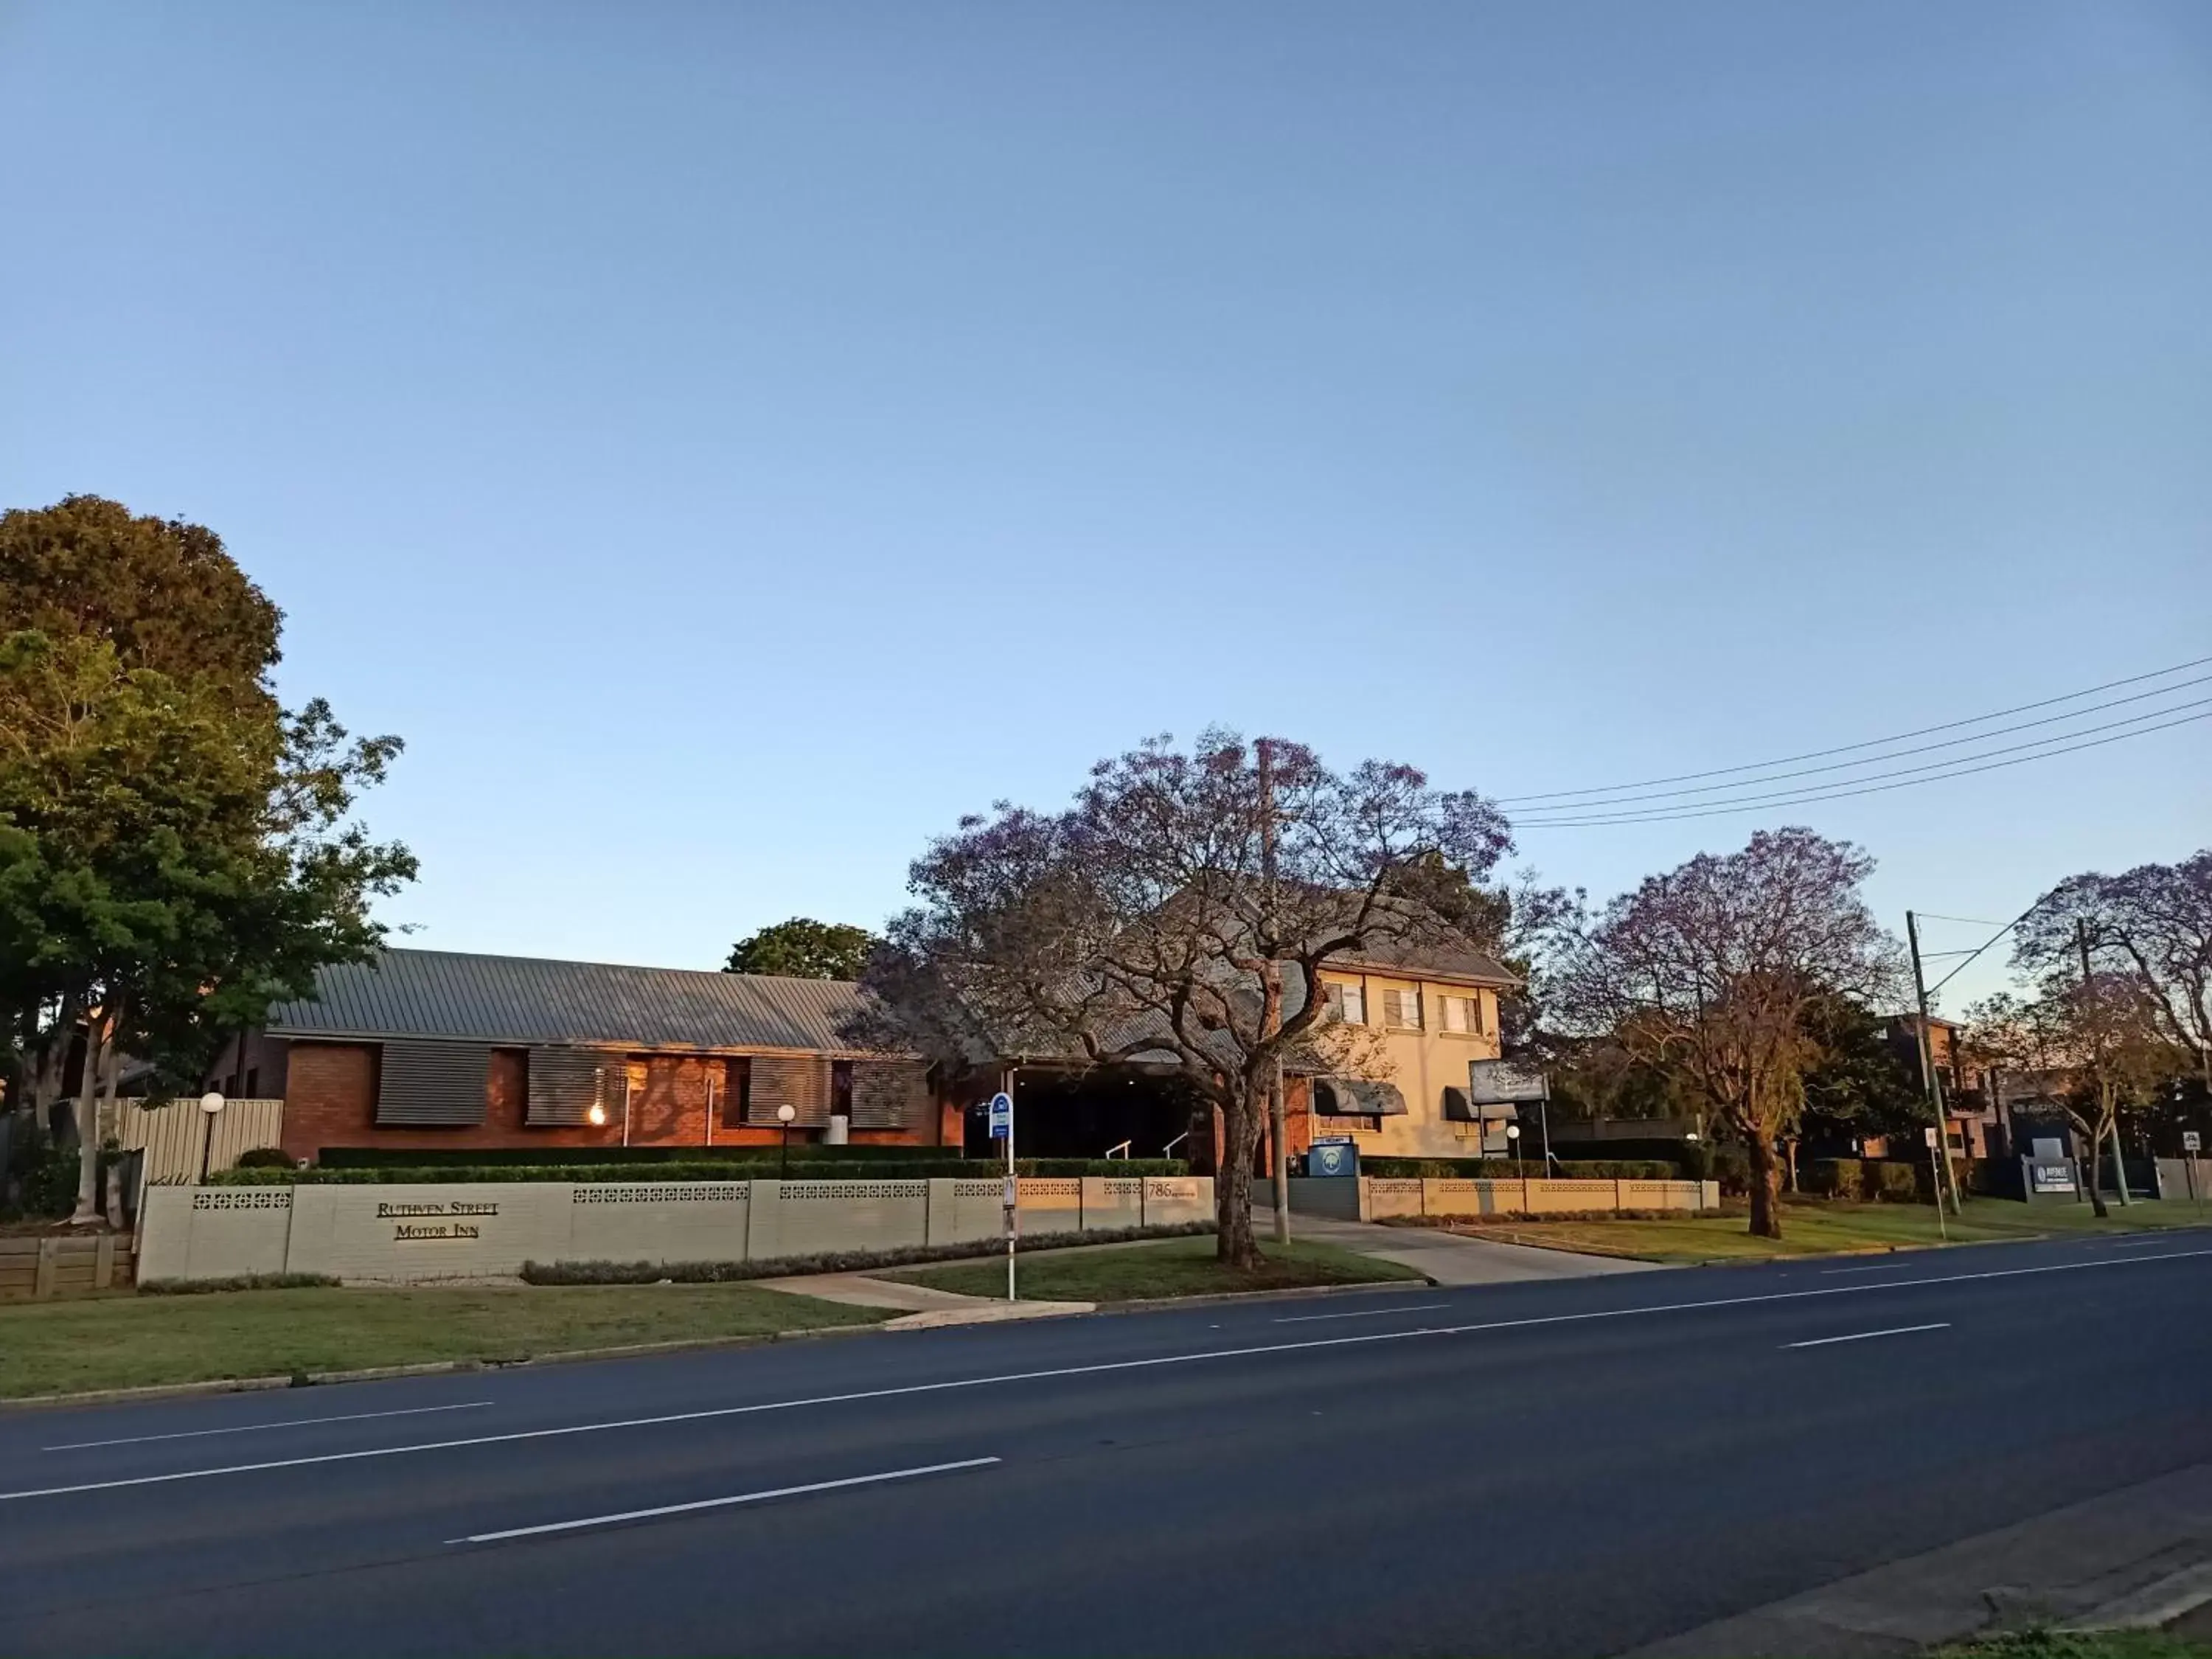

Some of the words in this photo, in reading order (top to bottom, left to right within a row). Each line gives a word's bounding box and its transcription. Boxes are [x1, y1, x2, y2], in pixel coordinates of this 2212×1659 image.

[1149, 1183, 1172, 1197] 786
[451, 1201, 500, 1215] STREET
[395, 1225, 448, 1239] MOTOR
[453, 1223, 479, 1238] INN
